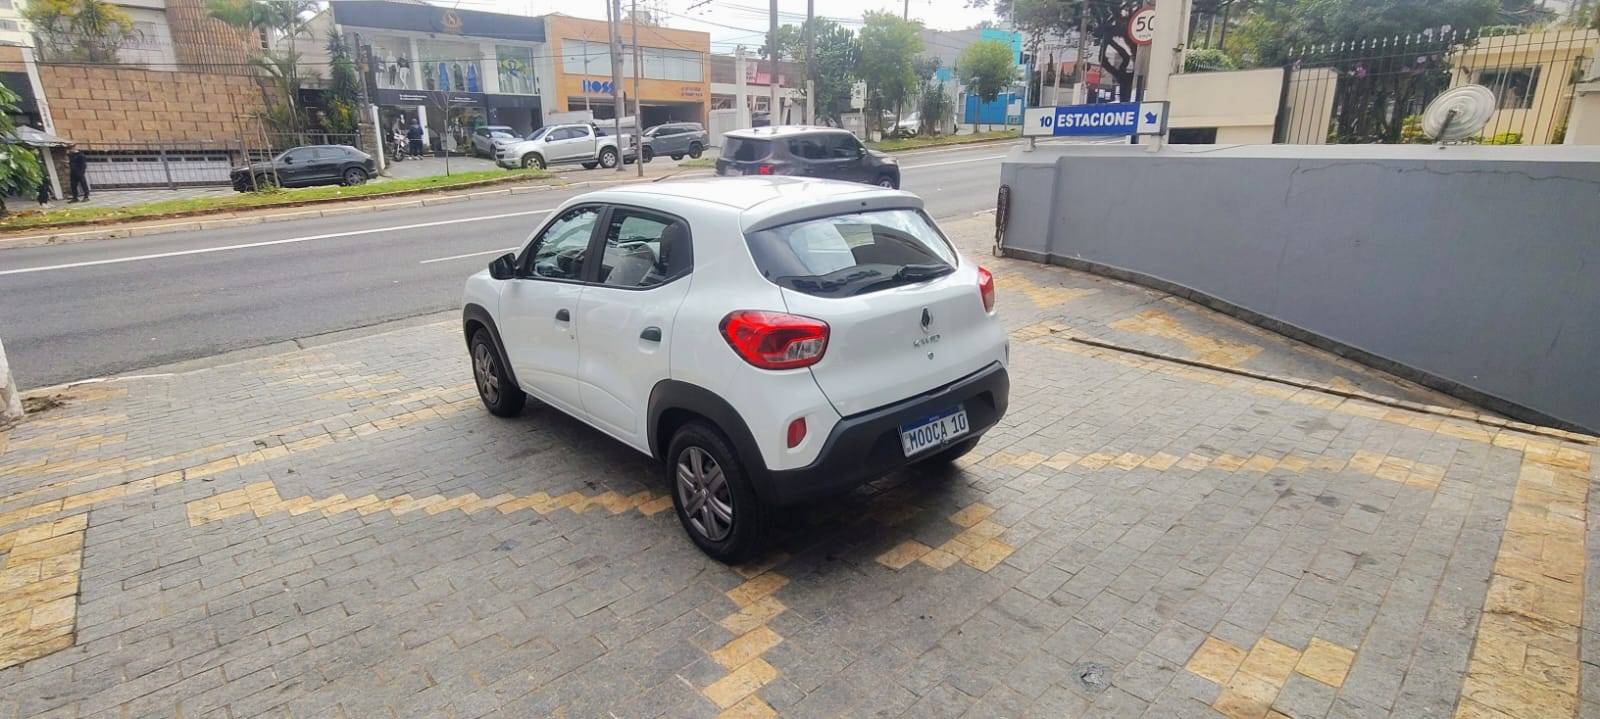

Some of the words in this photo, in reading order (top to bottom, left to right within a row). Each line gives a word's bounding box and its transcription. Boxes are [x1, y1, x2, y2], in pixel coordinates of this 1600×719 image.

[1040, 115, 1053, 127] 10
[1057, 112, 1135, 127] ESTACIONE
[909, 420, 948, 451] MOOCA
[951, 413, 967, 434] 10
